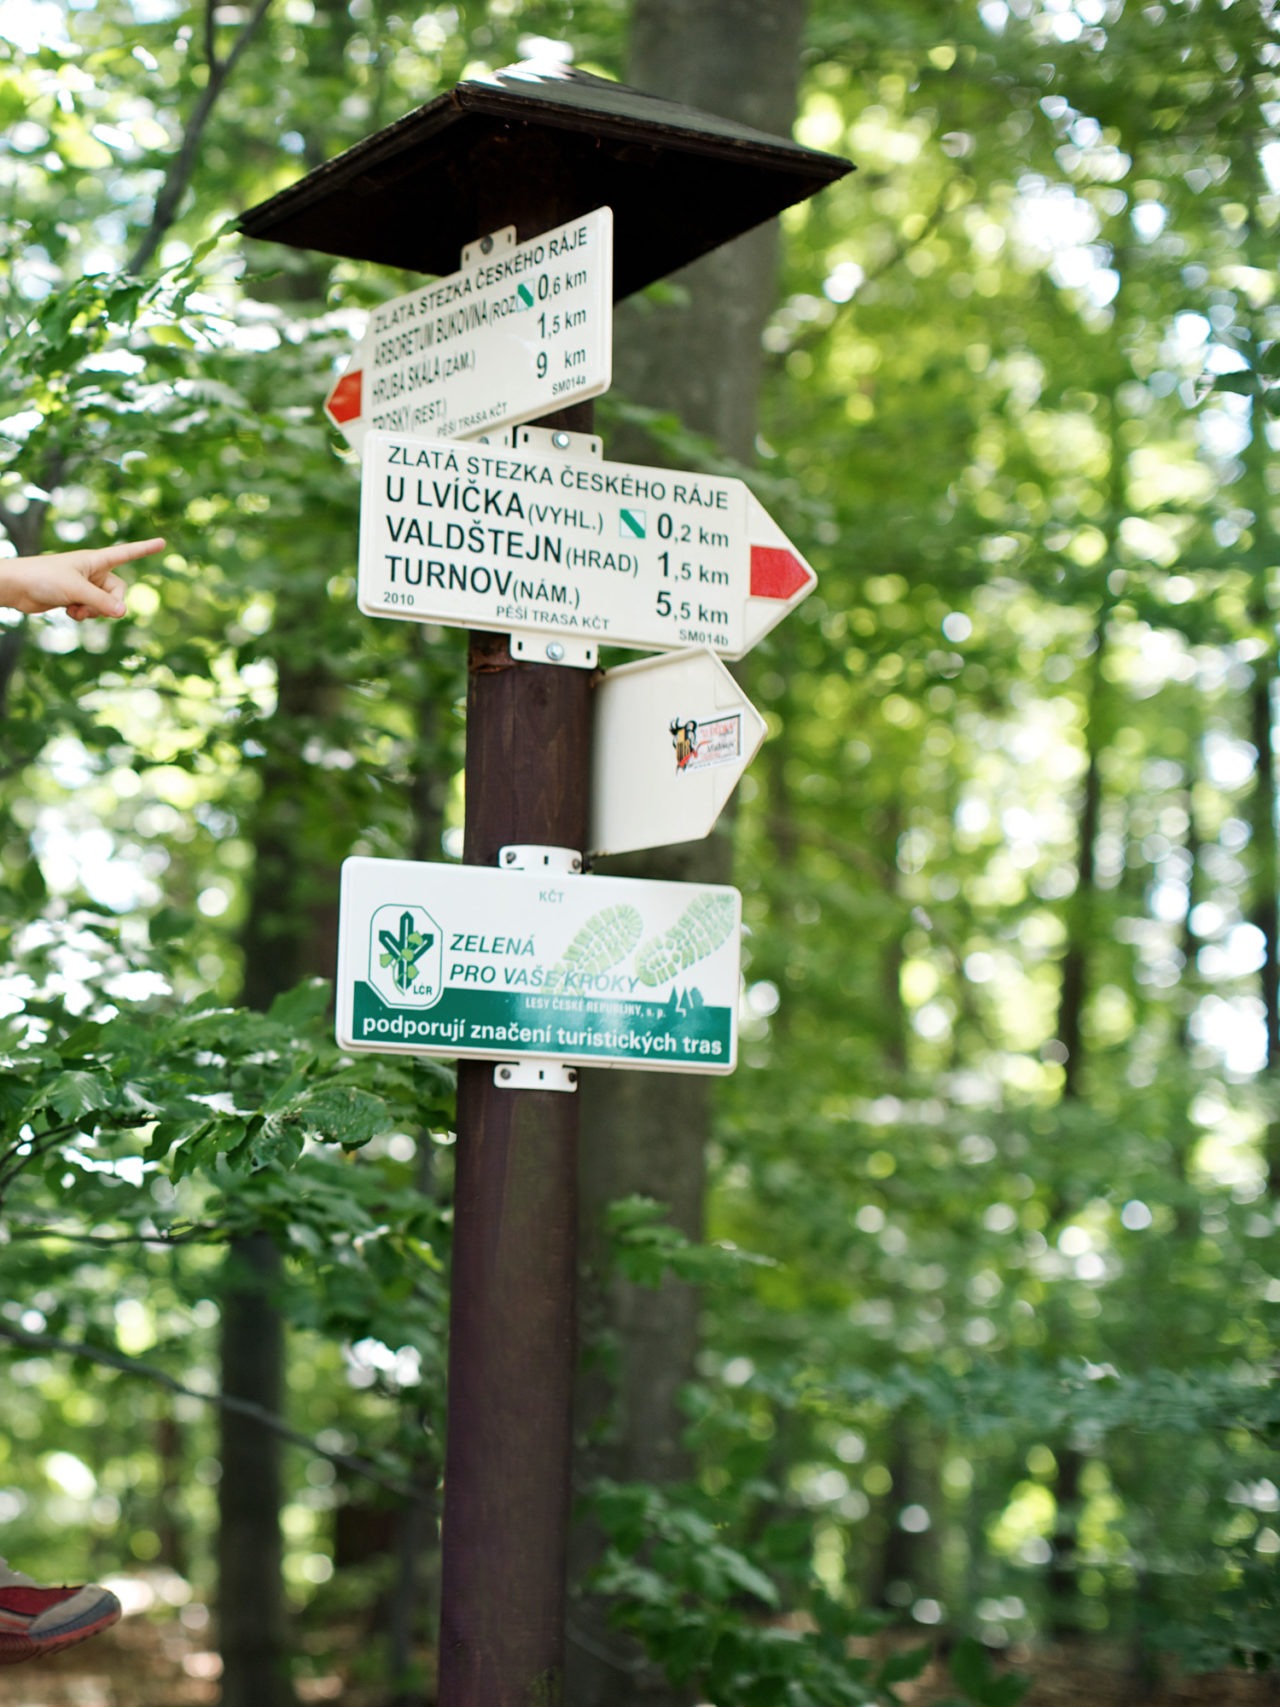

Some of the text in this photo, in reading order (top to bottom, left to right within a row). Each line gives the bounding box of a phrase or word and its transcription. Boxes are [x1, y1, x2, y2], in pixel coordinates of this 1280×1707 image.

[419, 277, 472, 314] STEZKA
[476, 245, 545, 290] ČESKÉHO
[549, 226, 587, 260] RÁJE
[537, 273, 561, 301] 0,6
[565, 269, 587, 291] km
[537, 312, 561, 340] 1,5
[565, 308, 586, 331] km
[536, 351, 548, 379] 9
[564, 348, 586, 369] km
[387, 445, 728, 510] ZLATÁ STEZKA ČESKÉHO RÁJE
[386, 474, 405, 503] U
[657, 513, 691, 544] 0,2
[698, 526, 729, 548] km
[657, 551, 692, 581] 1,5
[698, 565, 729, 586] km
[383, 591, 415, 606] 2010
[656, 590, 692, 622] 5,5
[698, 604, 729, 625] km
[496, 604, 610, 631] PĚŠÍ TRASA KČT
[679, 629, 729, 646] SM014b
[539, 889, 564, 903] KČT
[449, 933, 536, 957] ZELENÁ
[413, 984, 433, 996] LČR
[449, 963, 641, 993] PRO VAŠE KROKY
[525, 996, 551, 1009] LESY
[552, 997, 584, 1012] ČESKÉ
[363, 1015, 723, 1055] podporují značení turistických tras
